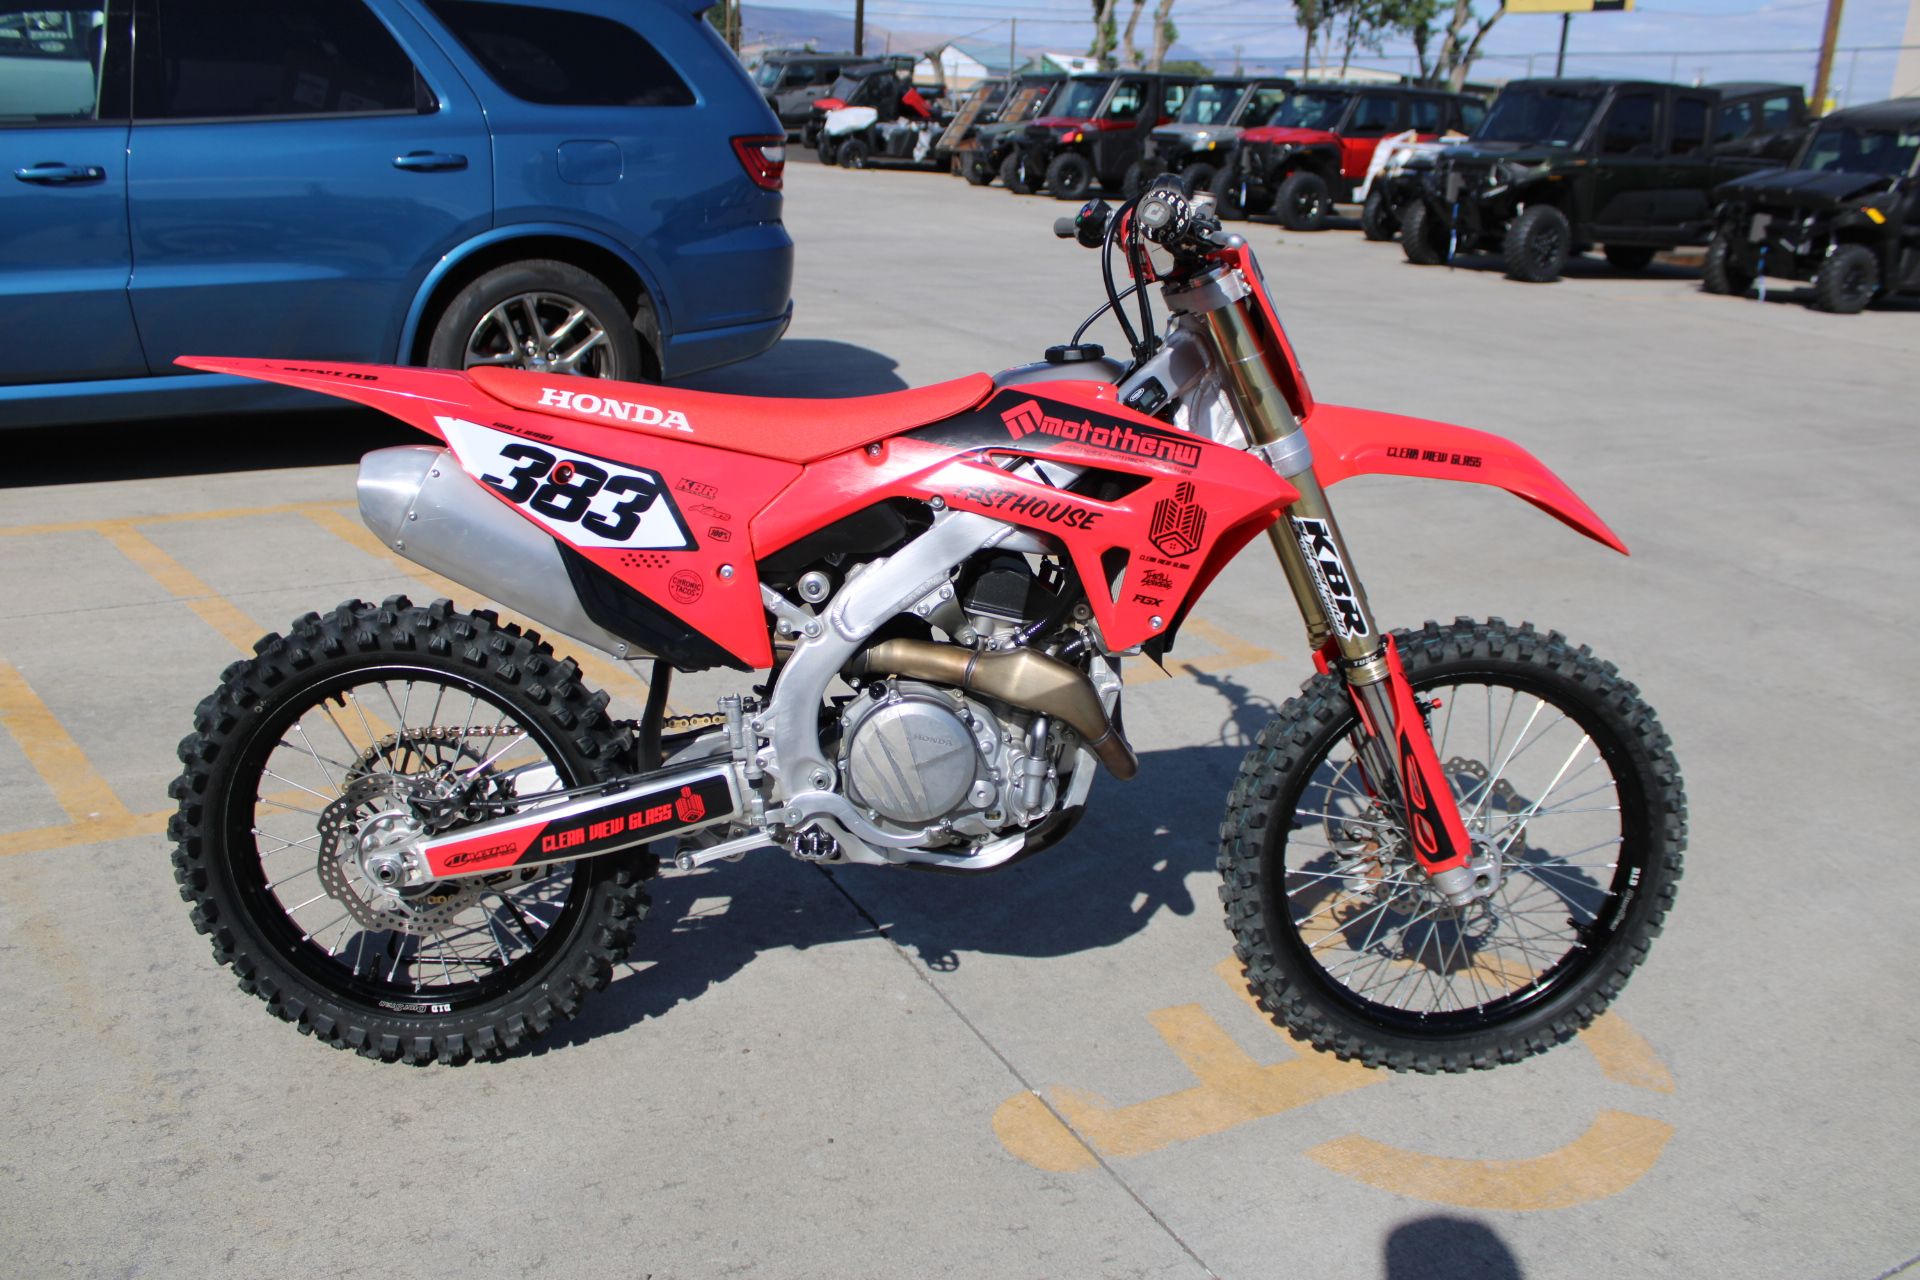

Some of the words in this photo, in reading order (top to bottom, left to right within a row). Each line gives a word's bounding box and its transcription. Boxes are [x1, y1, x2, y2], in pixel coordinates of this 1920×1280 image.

[538, 387, 694, 433] HONDA
[1451, 453, 1482, 468] GLASS
[480, 443, 661, 541] 383
[953, 486, 1104, 530] FASTHOUSE
[1302, 520, 1367, 635] KBR
[1353, 655, 1378, 667] TUSK
[913, 734, 953, 746] HONDA
[542, 827, 585, 853] CLEAN
[589, 816, 625, 840] VIEW
[628, 803, 673, 831] GLASS
